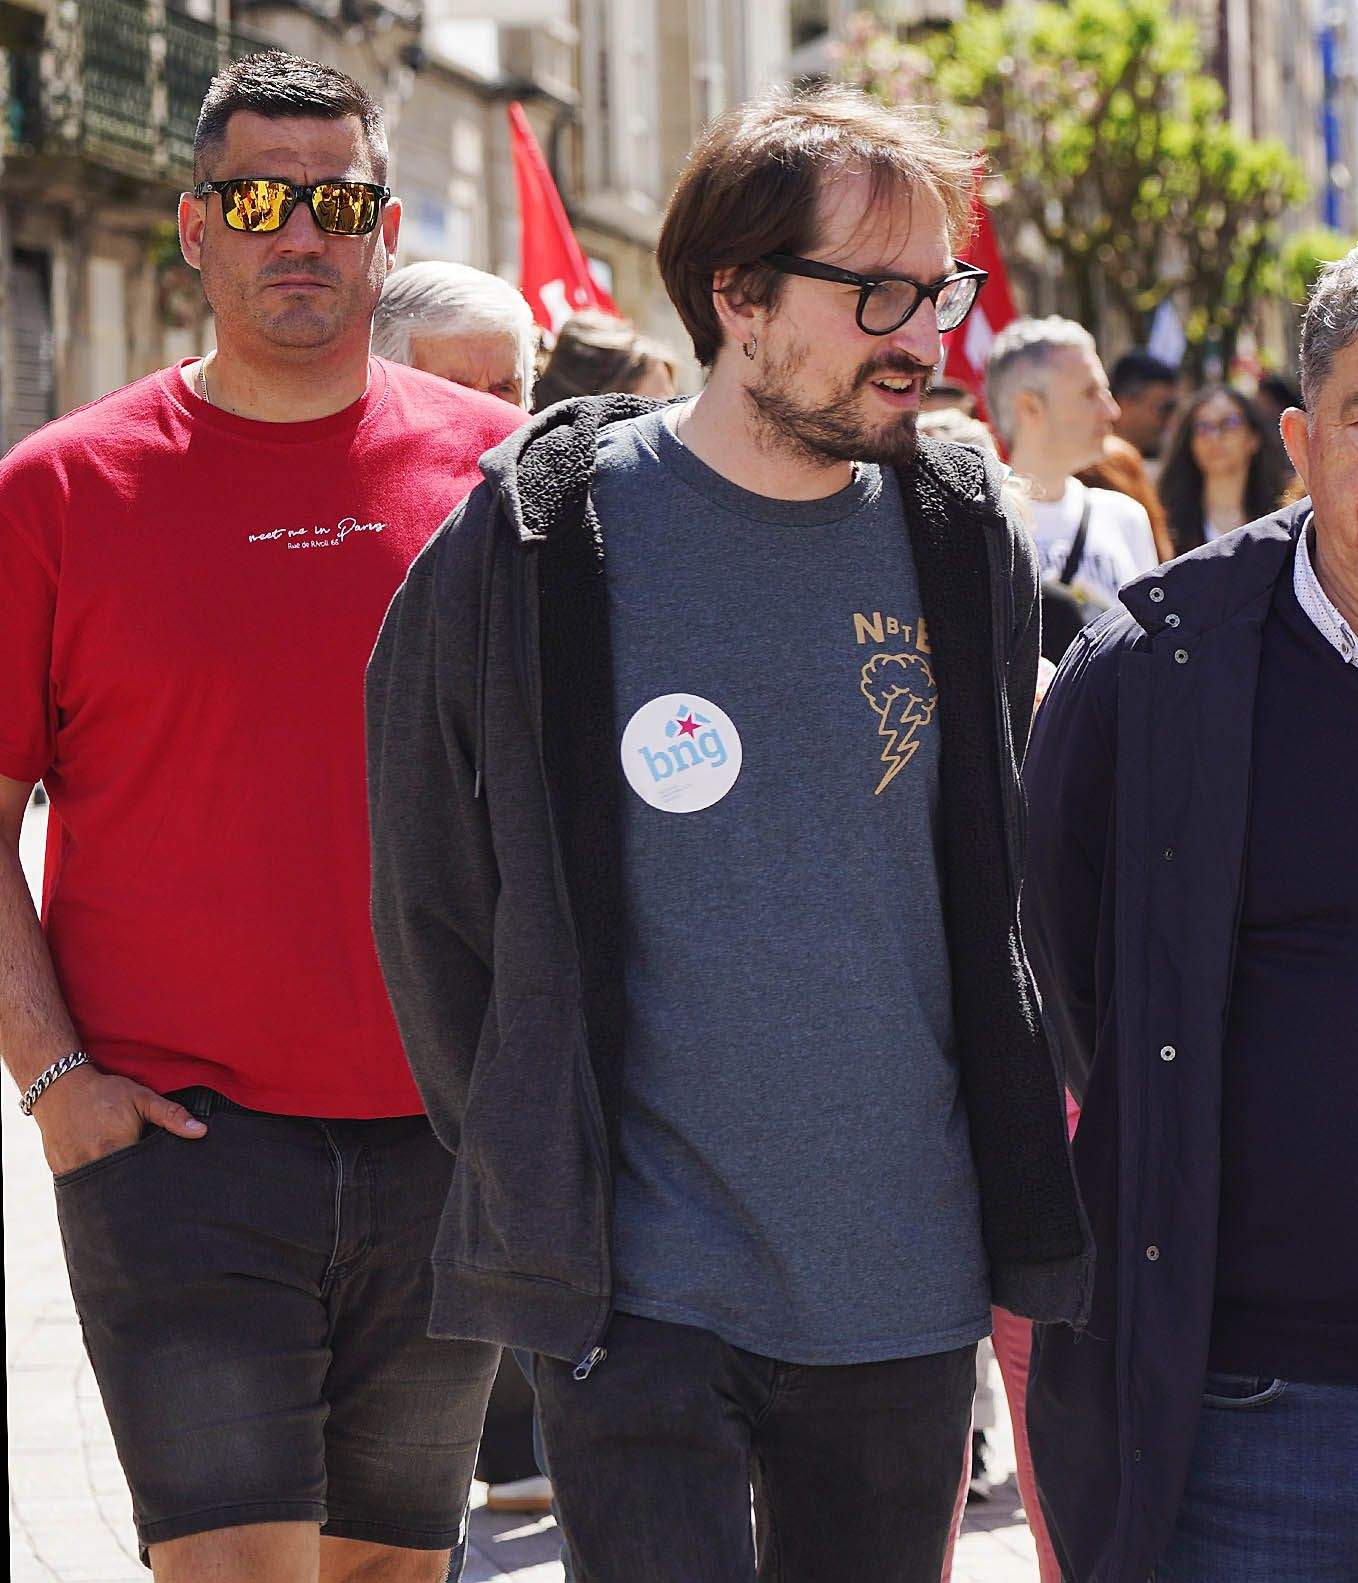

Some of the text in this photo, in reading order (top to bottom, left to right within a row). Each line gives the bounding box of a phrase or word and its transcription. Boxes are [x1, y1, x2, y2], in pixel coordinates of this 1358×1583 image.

[248, 517, 386, 543] meet me in Paris
[287, 542, 301, 550] Rue
[301, 540, 310, 548] de
[638, 729, 728, 783] bng
